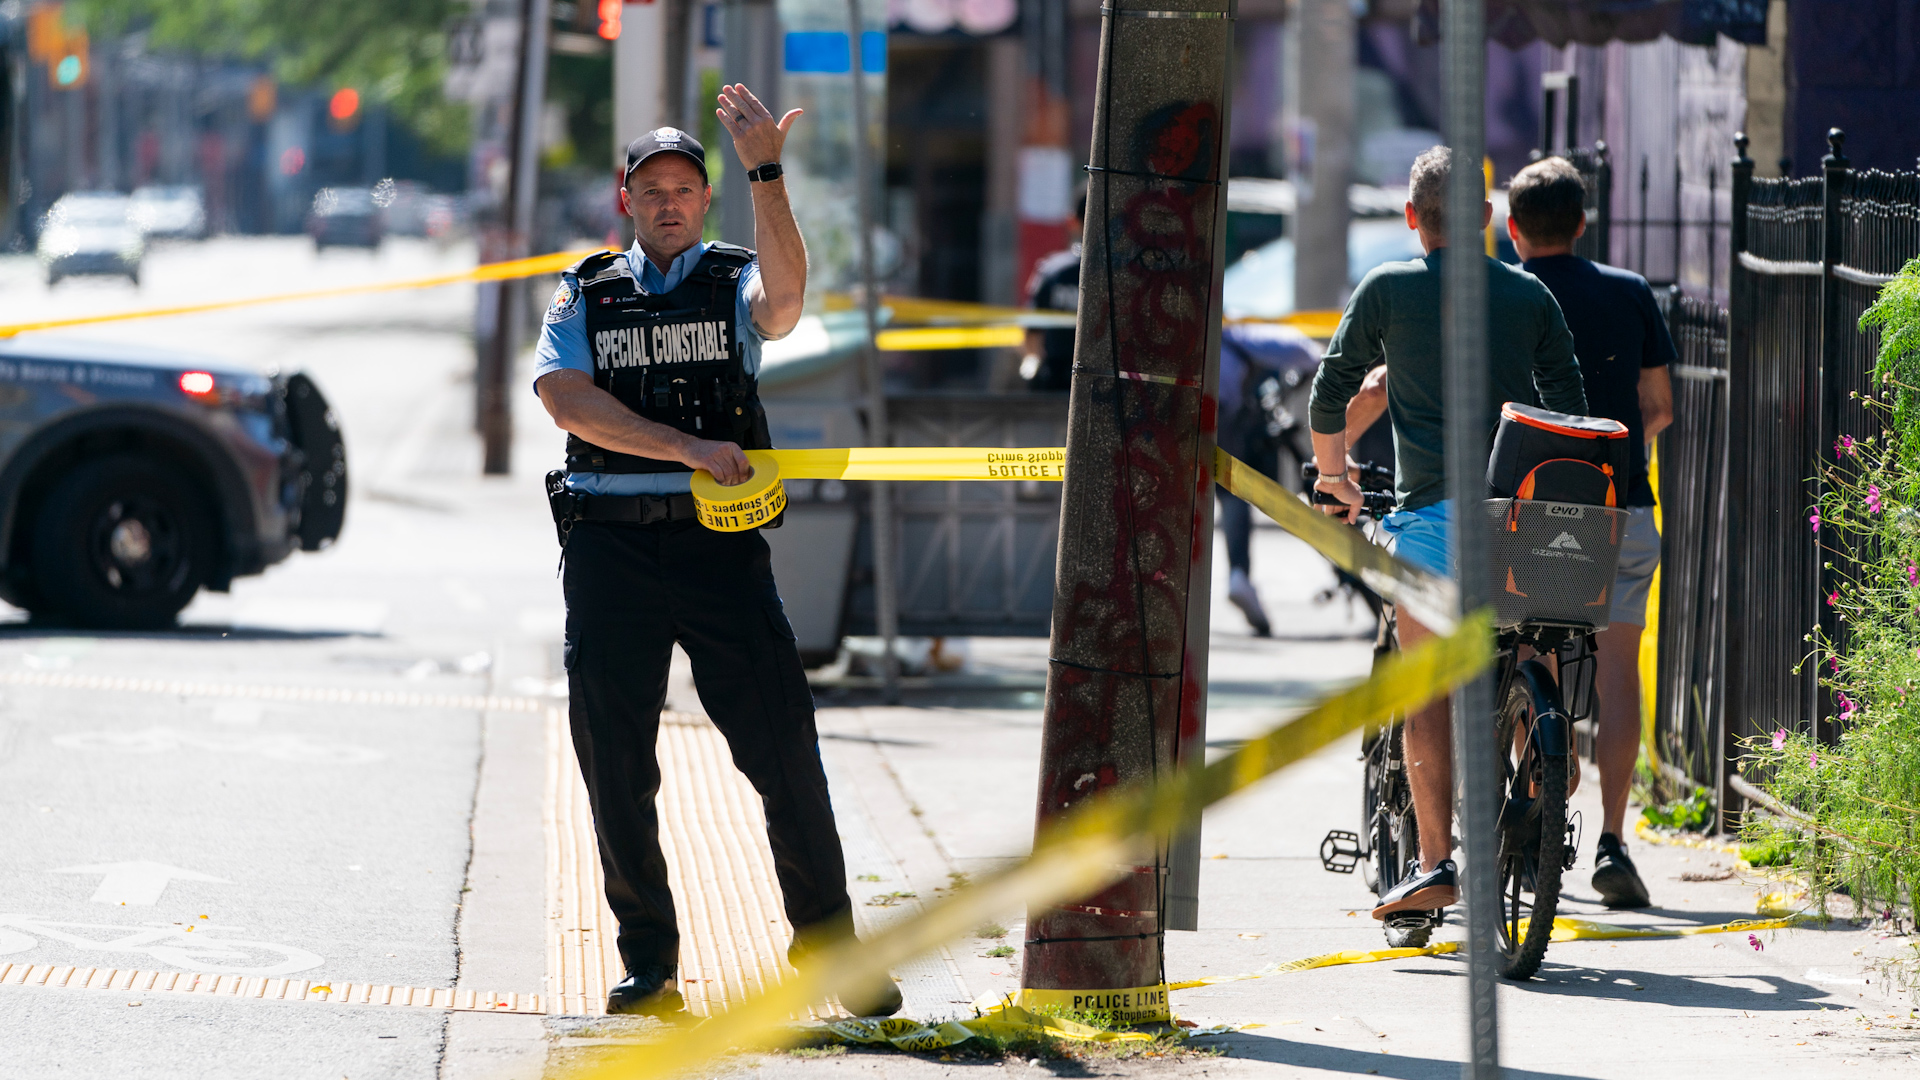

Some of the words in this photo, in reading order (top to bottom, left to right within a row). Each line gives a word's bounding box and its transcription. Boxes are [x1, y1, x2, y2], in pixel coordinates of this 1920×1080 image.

[595, 326, 651, 370] SPECIAL
[652, 320, 729, 364] CONSTABLE
[711, 498, 761, 513] Stoppers
[1551, 505, 1579, 516] evo
[706, 513, 739, 528] LINE
[1074, 994, 1130, 1009] POLICE
[1137, 991, 1164, 1006] LINE
[1112, 1009, 1157, 1022] Stoppers
